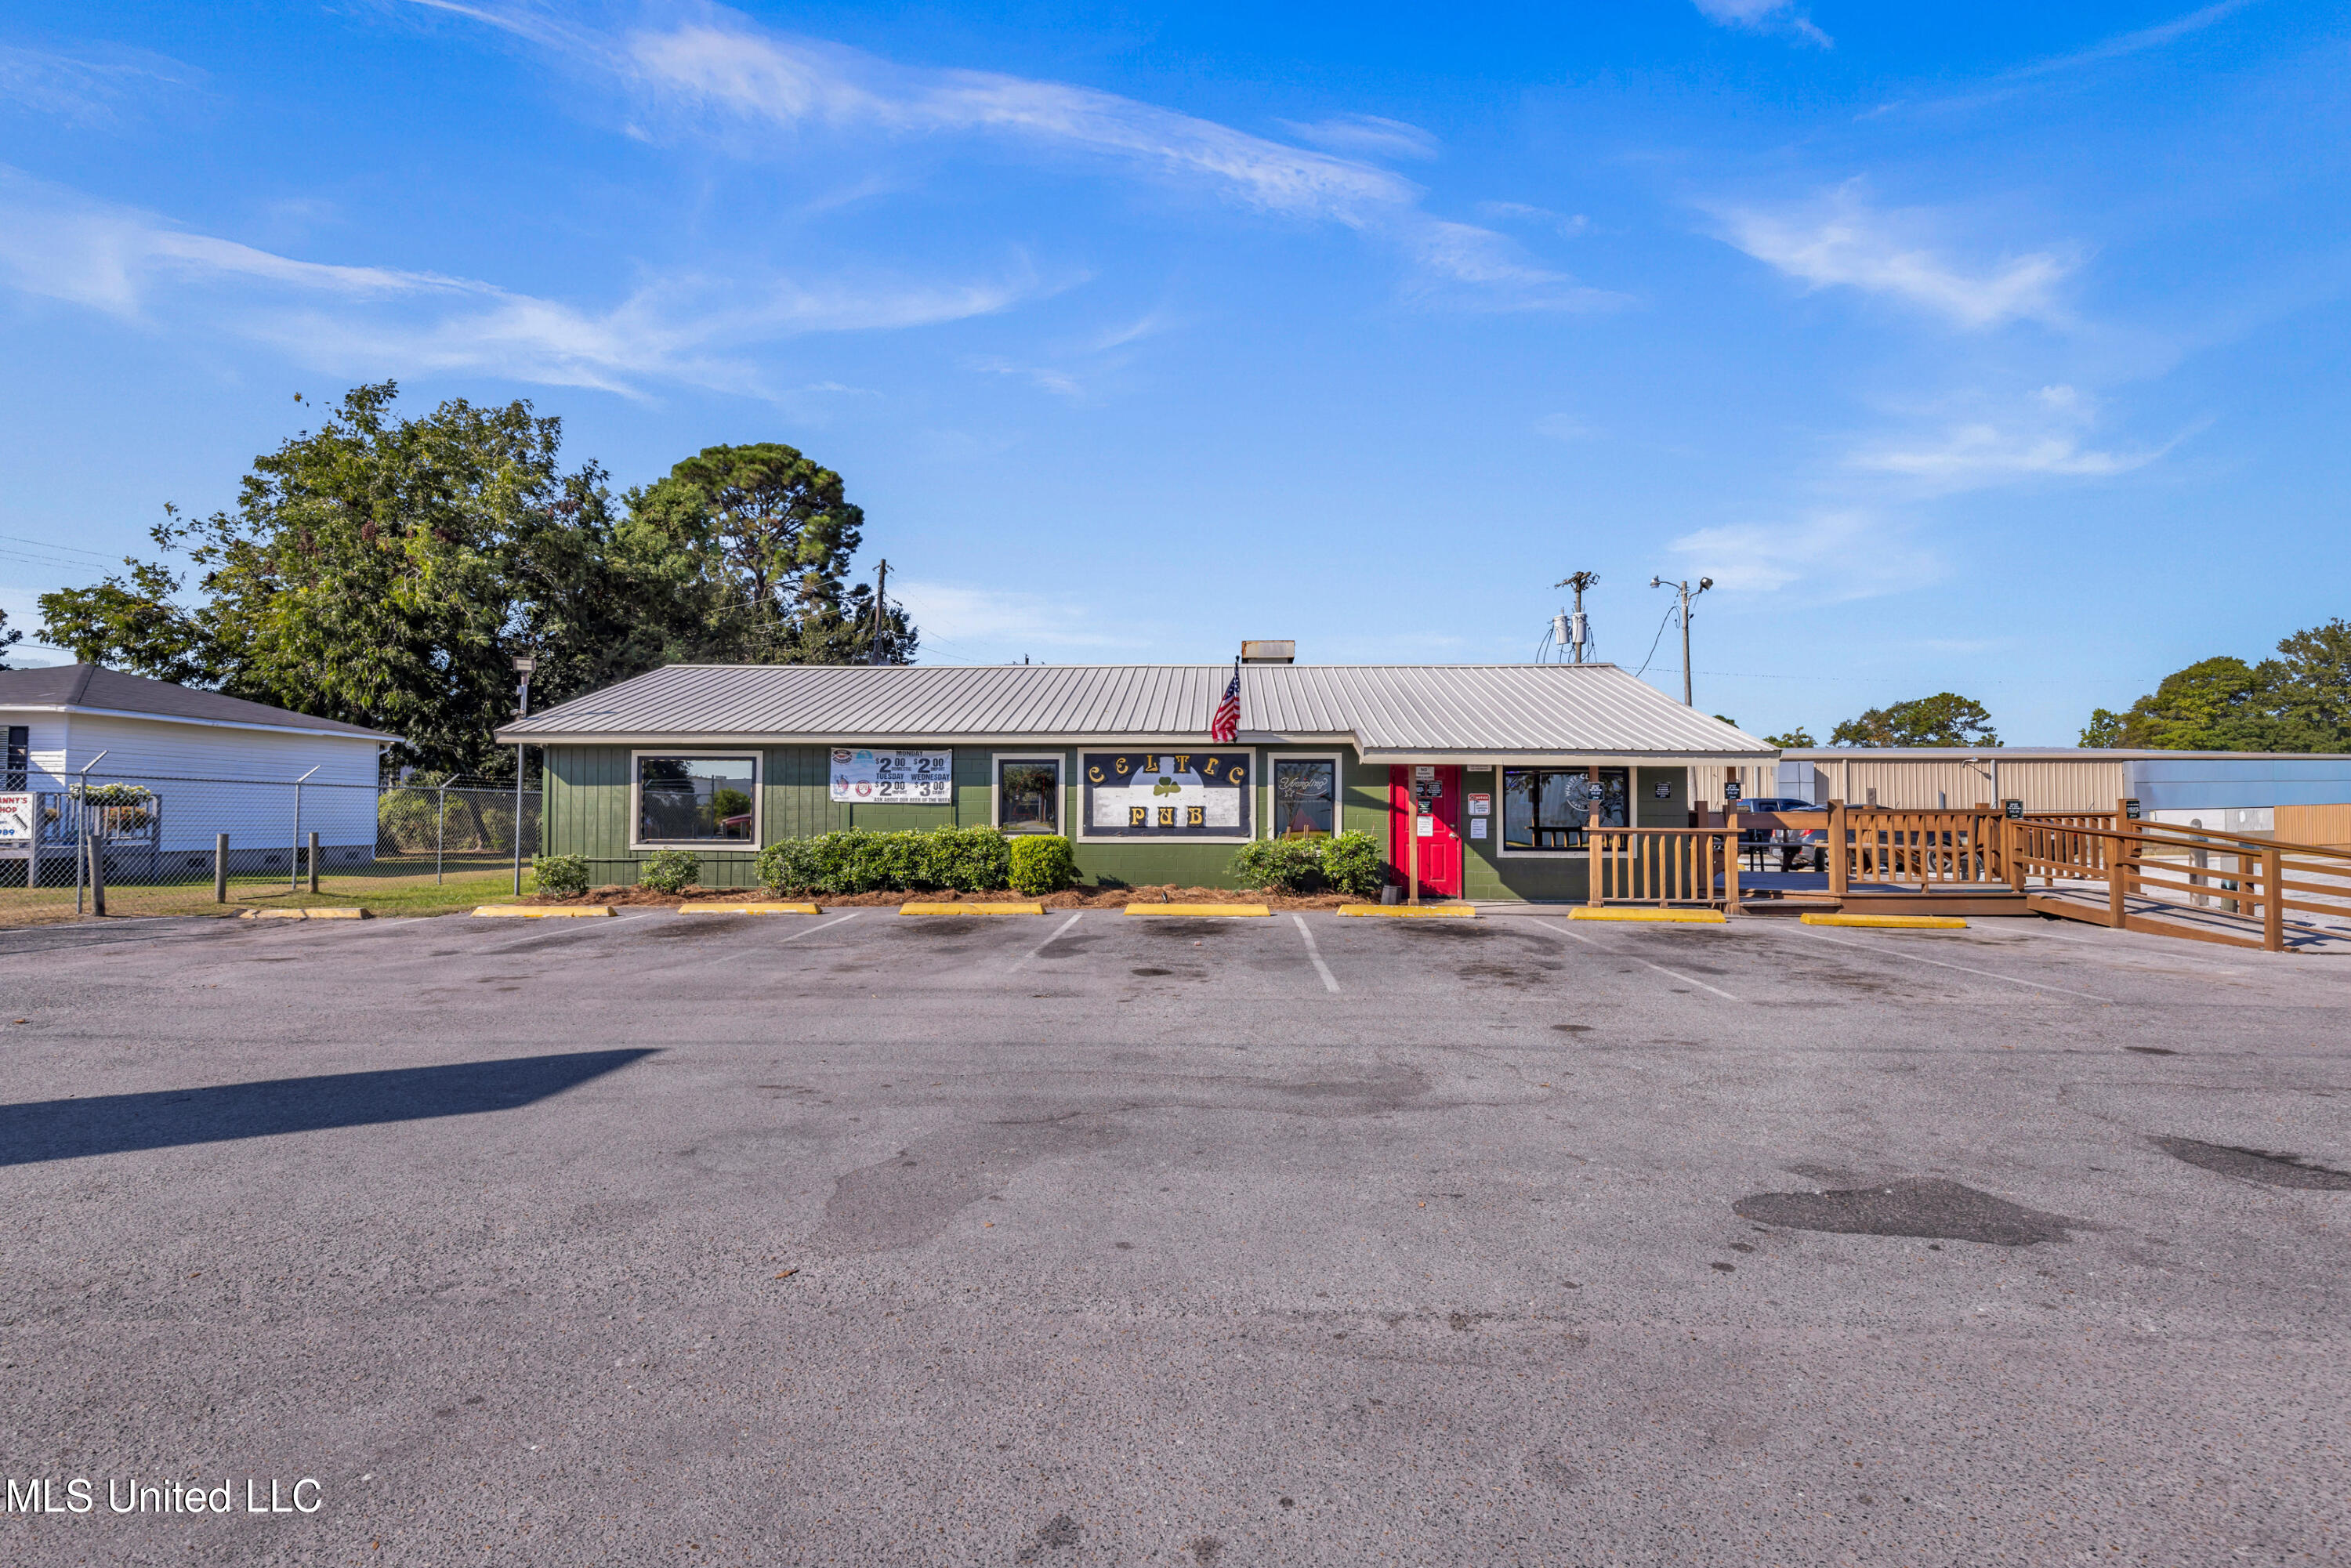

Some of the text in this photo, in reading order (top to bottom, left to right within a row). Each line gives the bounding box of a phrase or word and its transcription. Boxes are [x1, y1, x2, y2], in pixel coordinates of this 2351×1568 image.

[1089, 755, 1244, 784] CELTIC
[1565, 774, 1578, 797] WHITE
[1131, 807, 1203, 826] PUB
